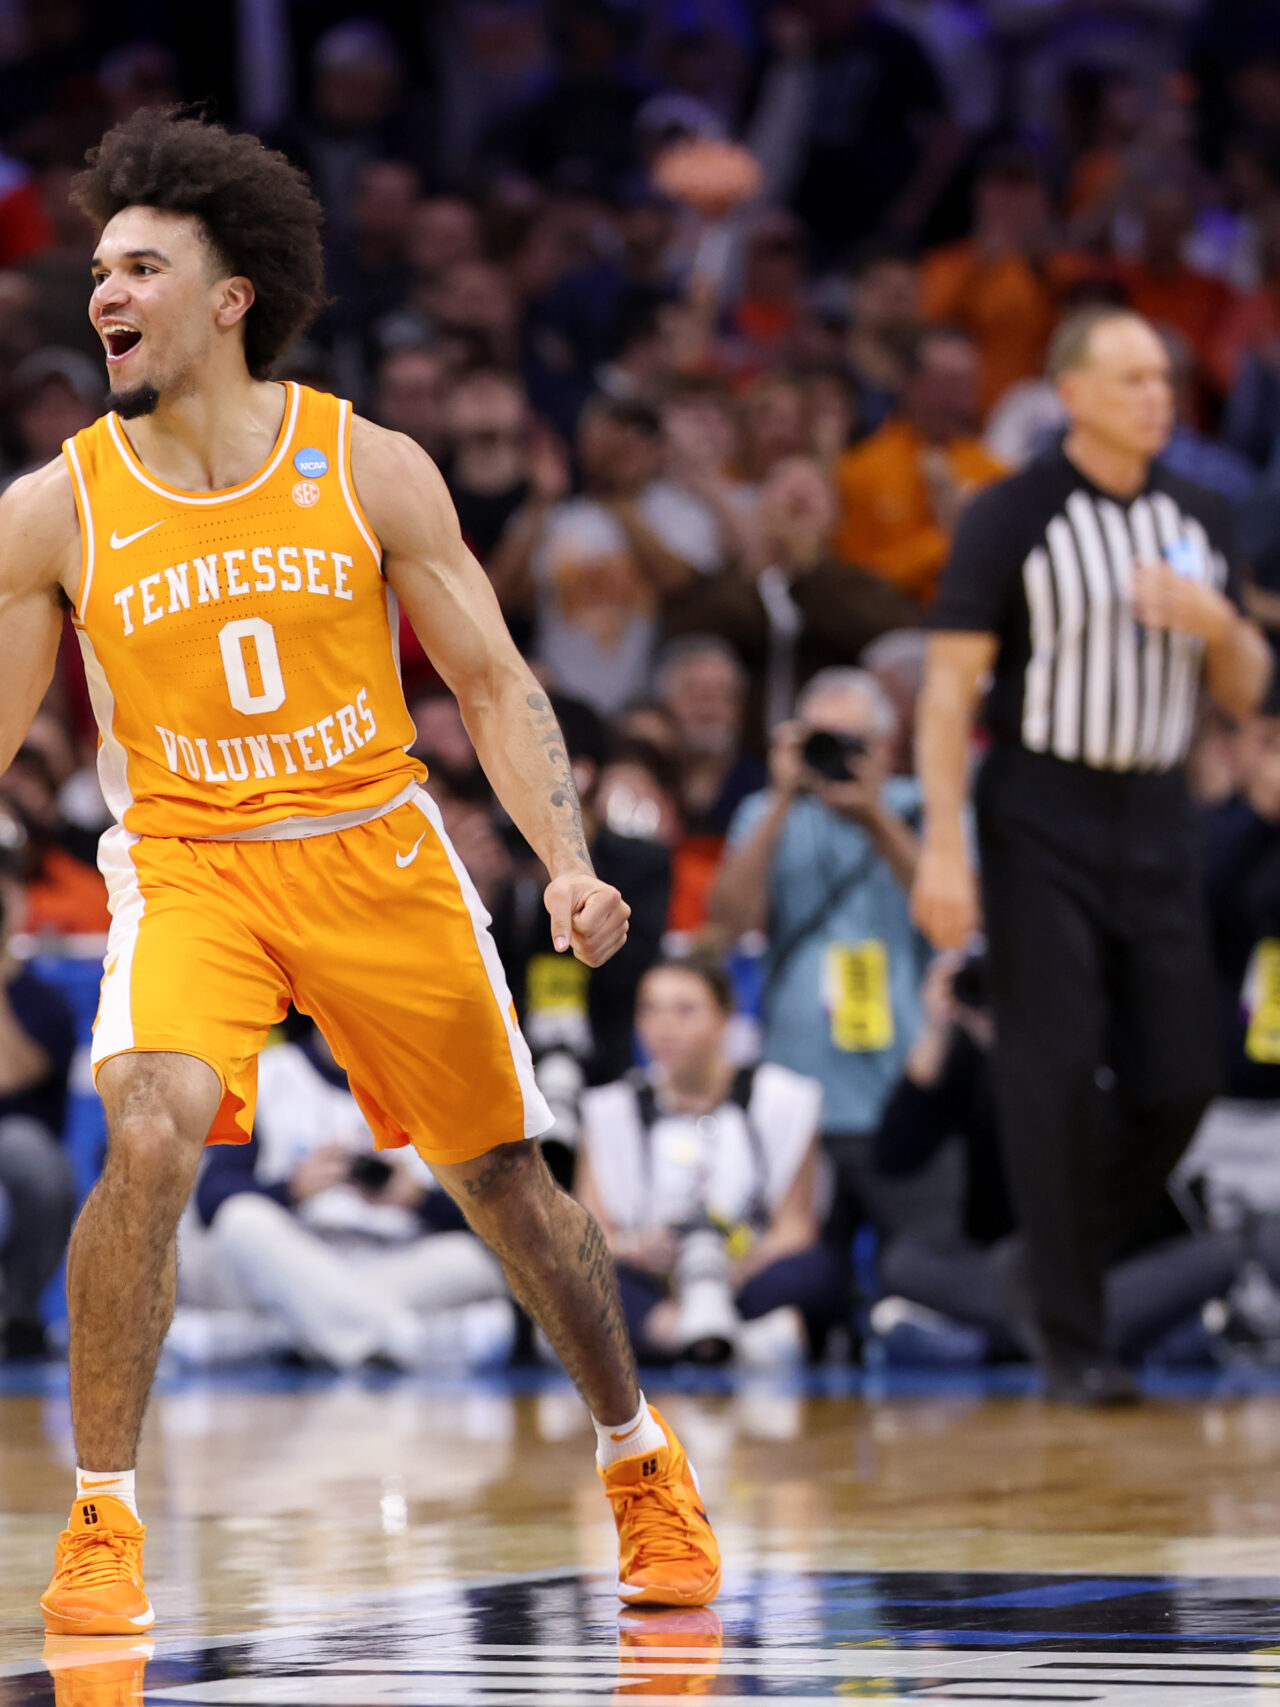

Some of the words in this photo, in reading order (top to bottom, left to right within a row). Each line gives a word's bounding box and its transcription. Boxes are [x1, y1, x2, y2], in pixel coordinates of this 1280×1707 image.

[114, 547, 353, 636] TENNESSEE
[218, 617, 286, 715] 0
[154, 687, 376, 782] VOLUNTEERS
